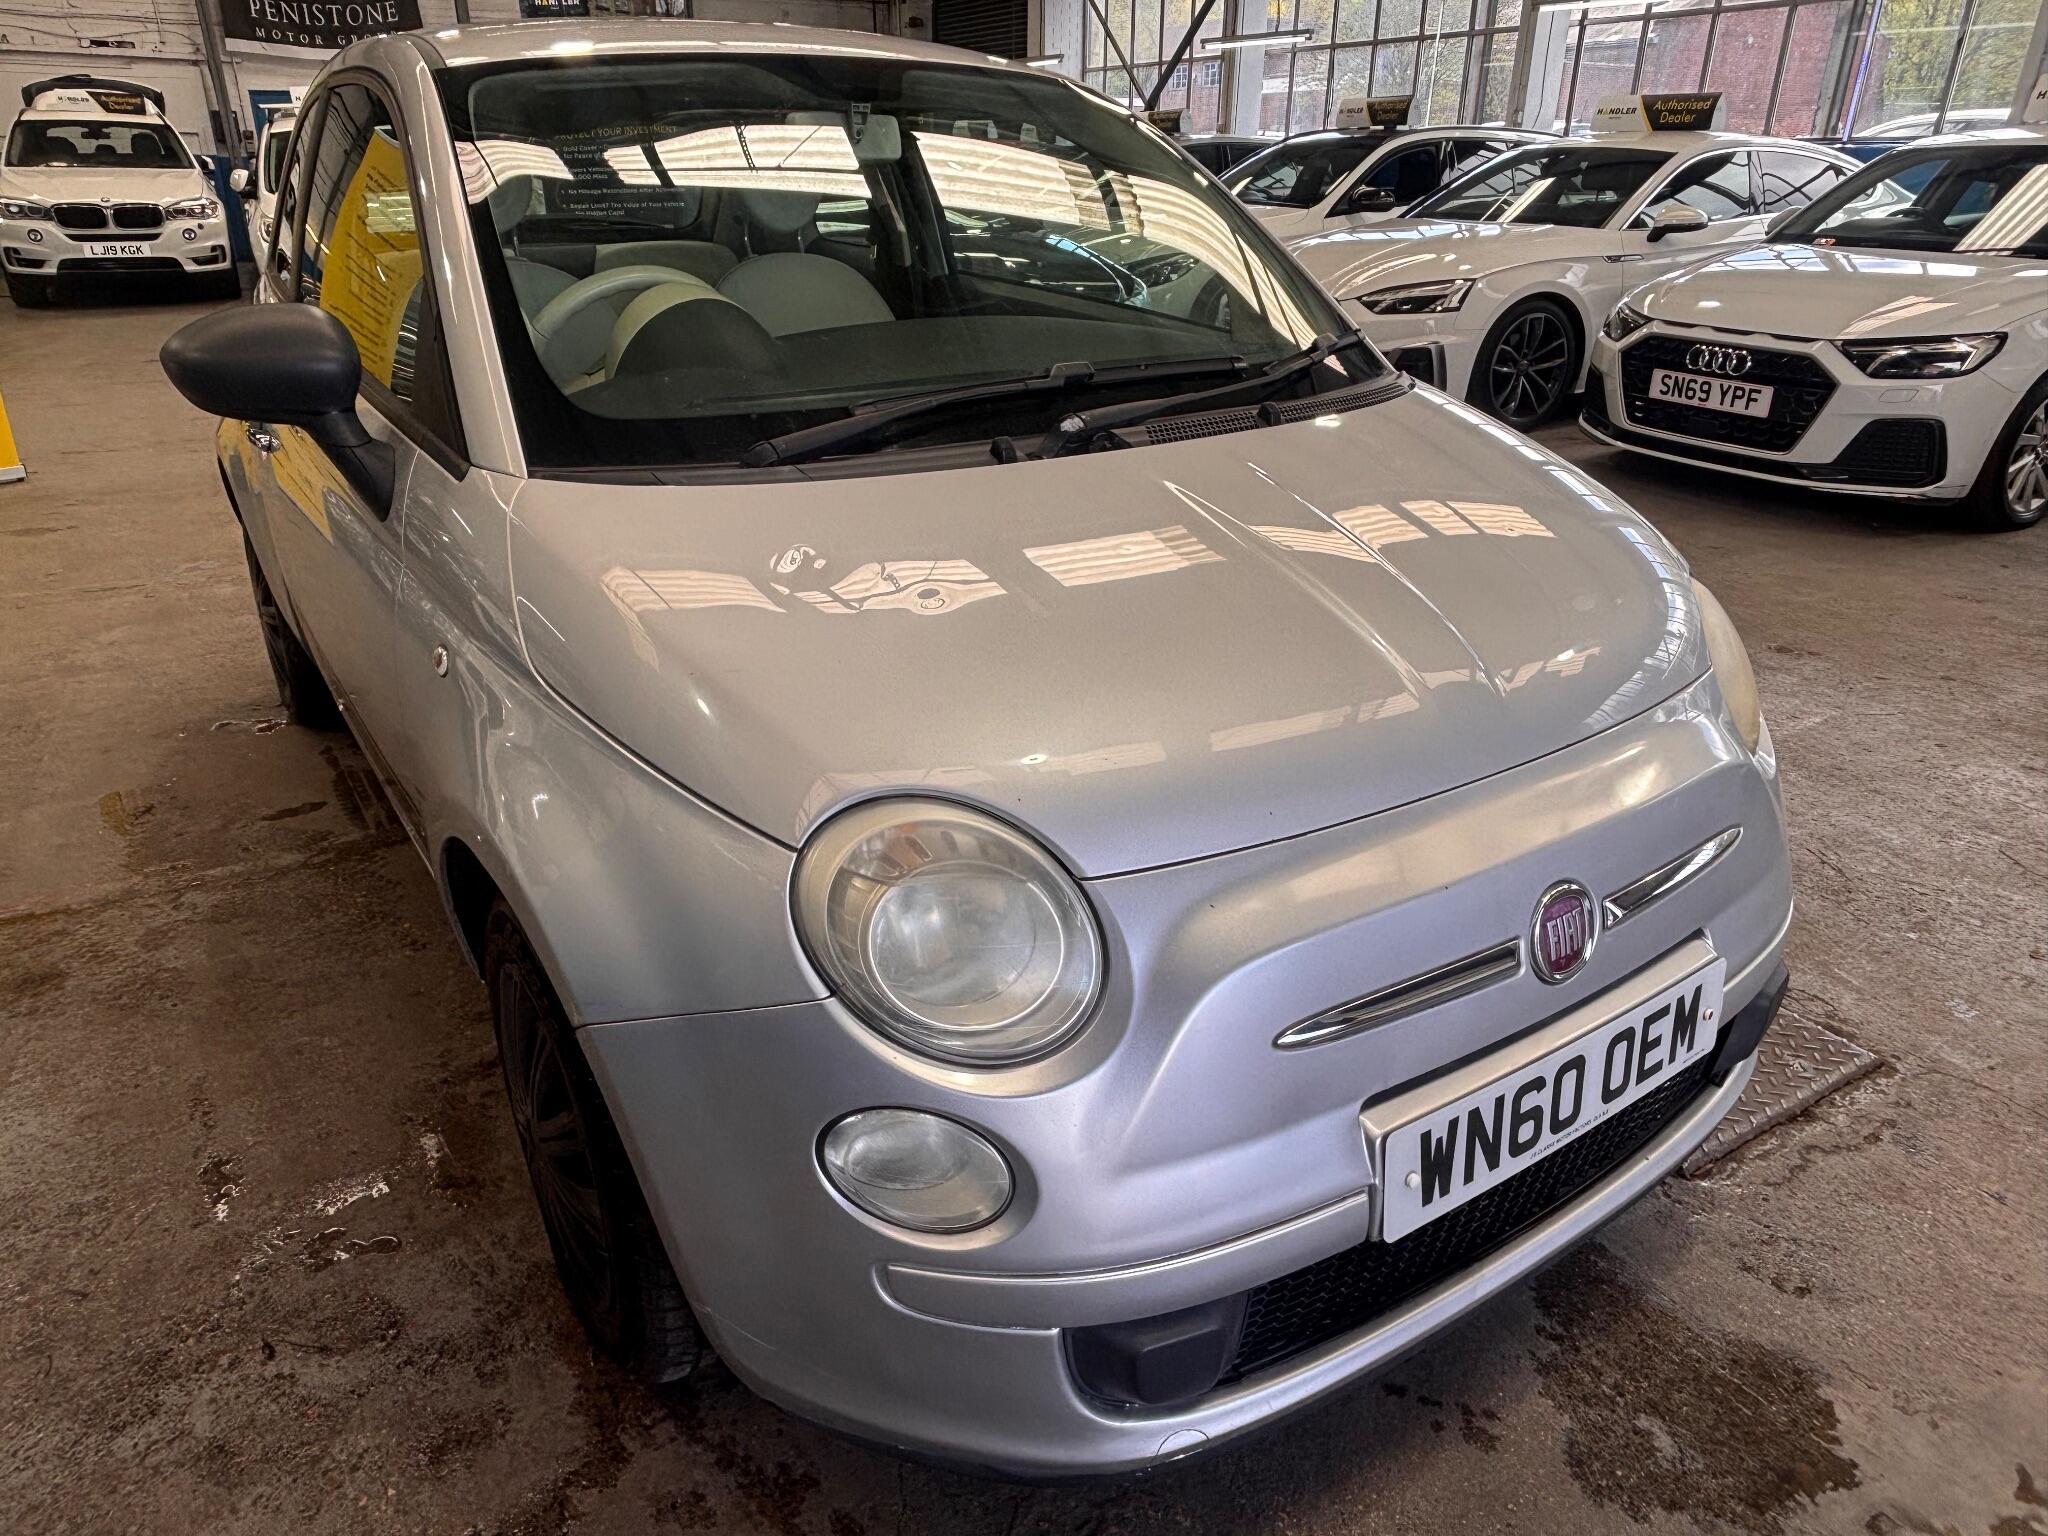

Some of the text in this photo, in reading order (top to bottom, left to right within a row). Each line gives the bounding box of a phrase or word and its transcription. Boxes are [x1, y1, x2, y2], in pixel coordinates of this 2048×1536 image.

[249, 0, 399, 27] PENISTONE
[255, 27, 324, 45] MOTOR
[1653, 99, 1713, 111] Authorised
[1659, 112, 1696, 123] Dealer
[90, 245, 144, 256] LJ19 KGK
[1659, 373, 1762, 411] SN69 YPF
[1546, 906, 1582, 962] FIAT
[1420, 983, 1703, 1208] WN60 OEM
